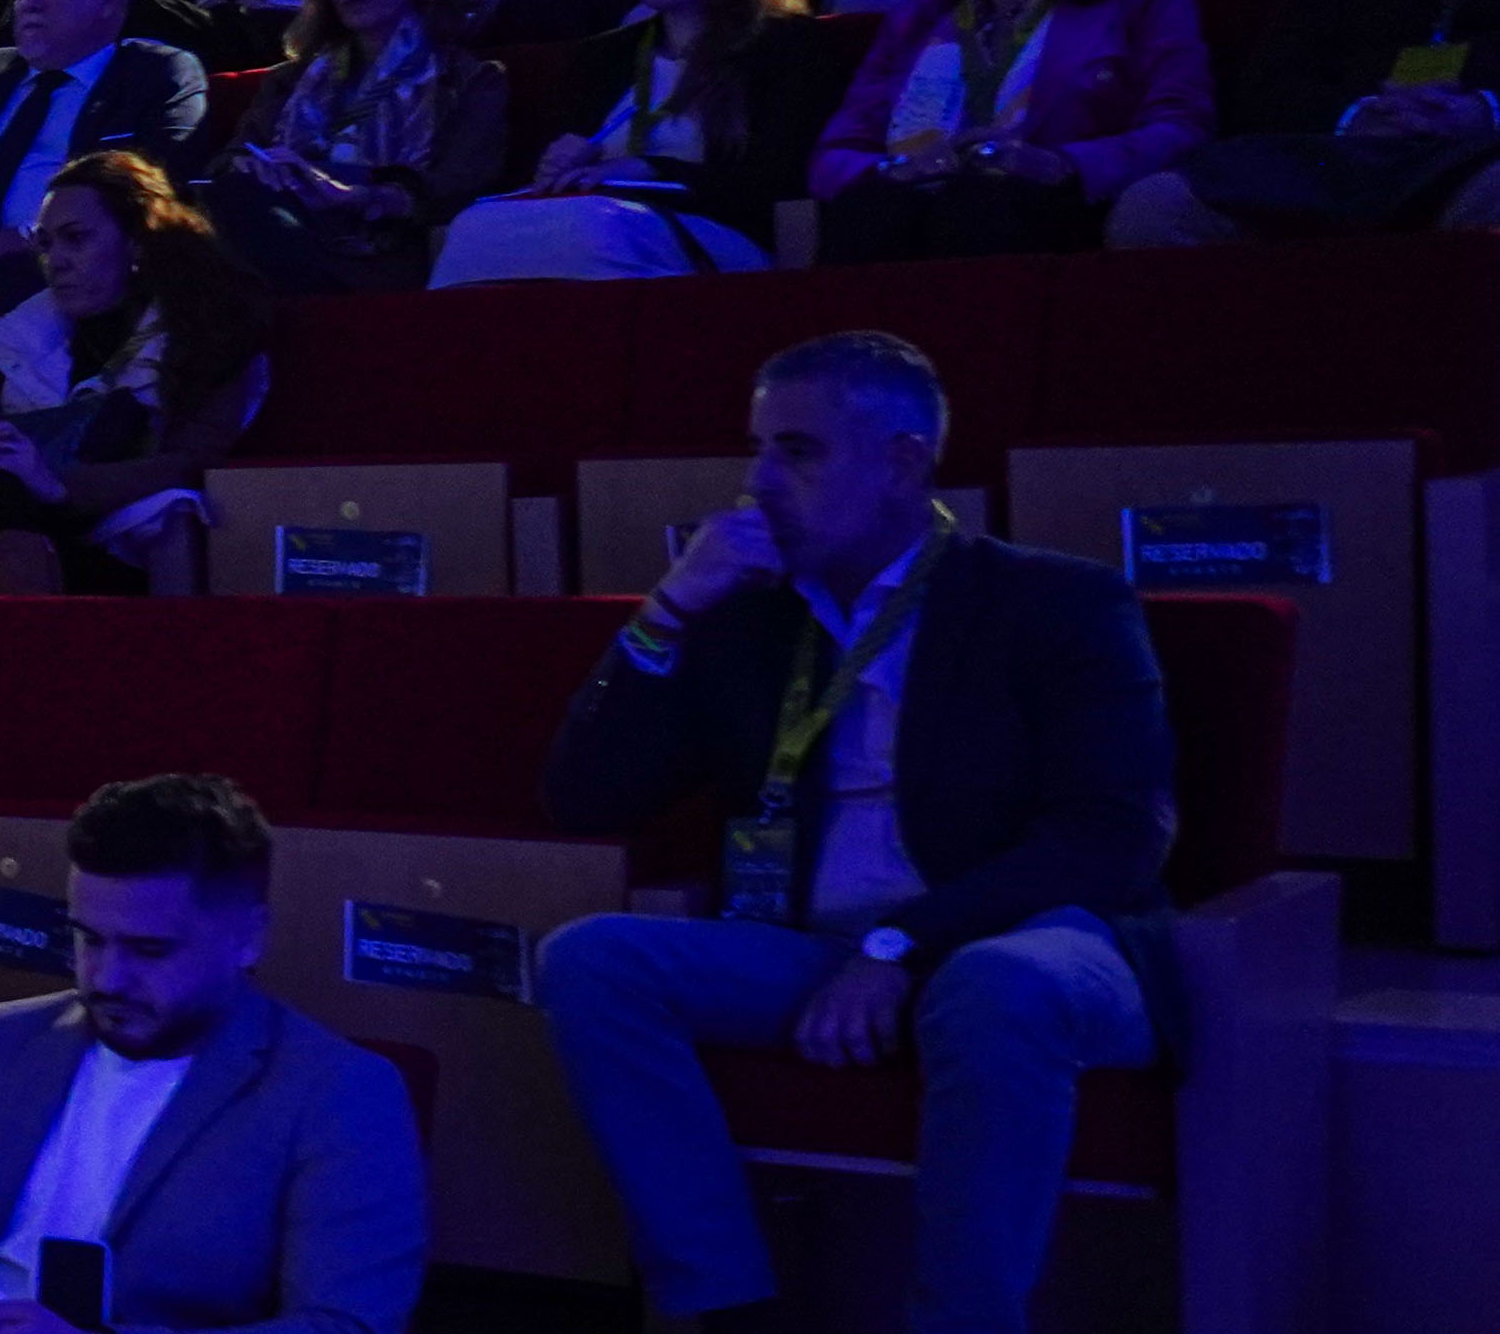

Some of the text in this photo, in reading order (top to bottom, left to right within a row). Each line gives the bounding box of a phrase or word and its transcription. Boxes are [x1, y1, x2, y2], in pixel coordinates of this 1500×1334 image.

[1140, 541, 1267, 562] RESERVADO
[286, 558, 381, 578] RESERVADO
[356, 938, 473, 972] RESERVADO
